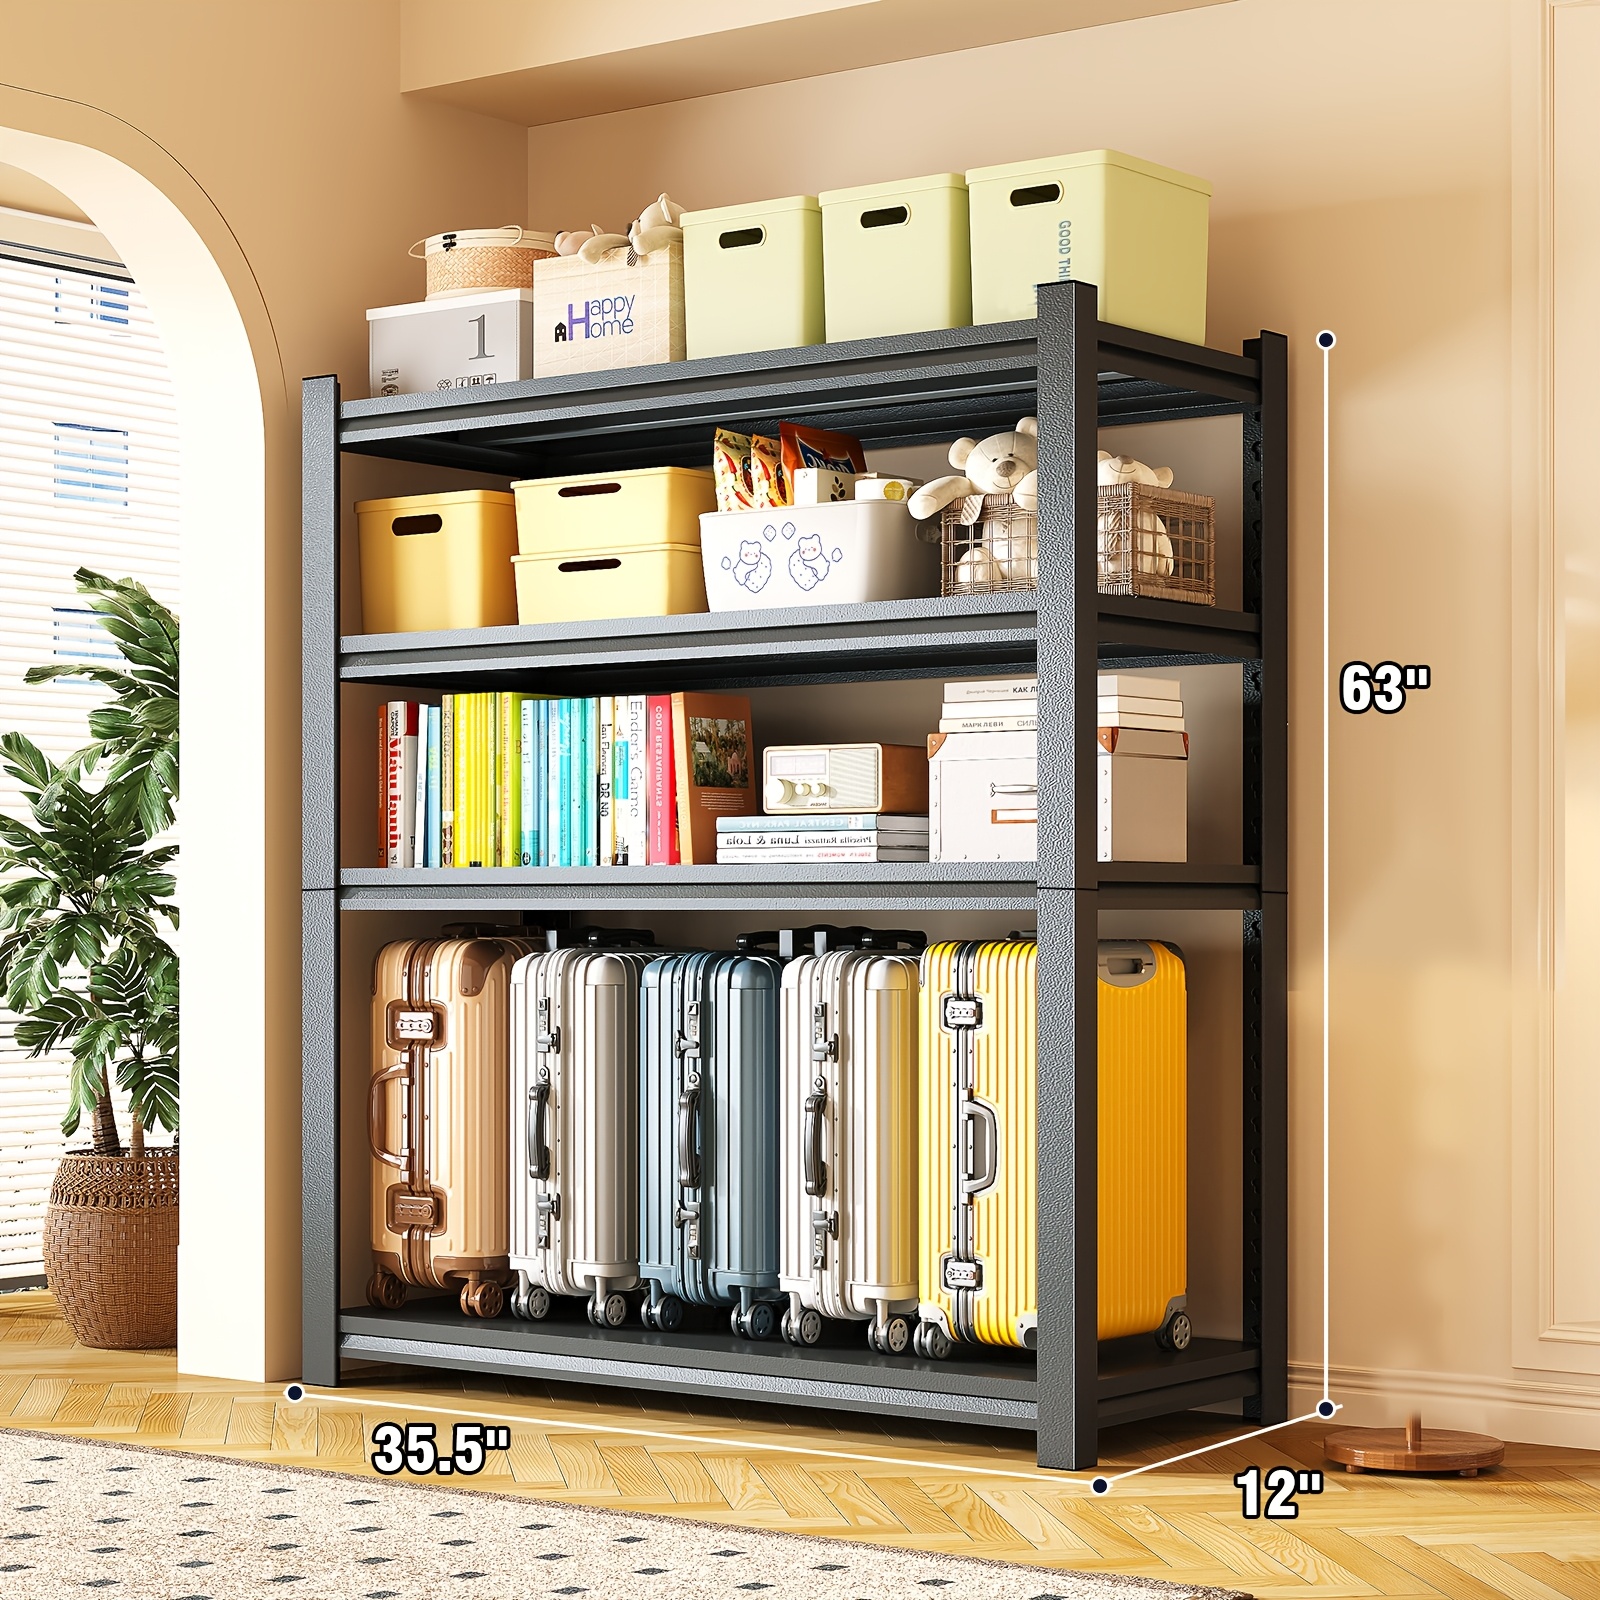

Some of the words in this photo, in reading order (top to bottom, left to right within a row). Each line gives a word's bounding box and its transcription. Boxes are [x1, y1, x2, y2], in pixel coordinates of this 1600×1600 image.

[1058, 220, 1072, 255] GOOD
[1058, 257, 1071, 281] THI
[468, 313, 496, 361] 1
[1012, 686, 1029, 694] КАК
[601, 723, 612, 740] Ian
[630, 701, 643, 761] Ender's
[983, 720, 1004, 728] ЛЕВИ
[599, 783, 610, 799] DR
[630, 766, 643, 818] Game
